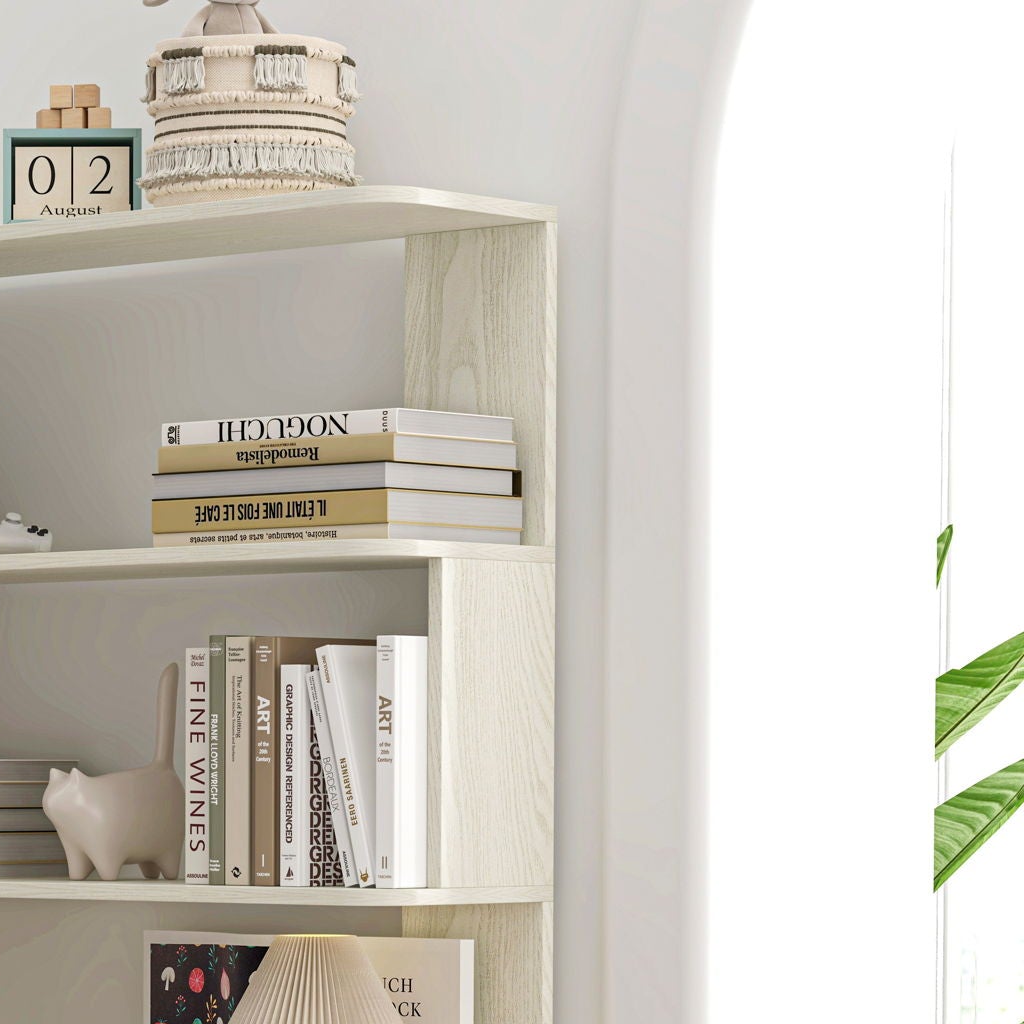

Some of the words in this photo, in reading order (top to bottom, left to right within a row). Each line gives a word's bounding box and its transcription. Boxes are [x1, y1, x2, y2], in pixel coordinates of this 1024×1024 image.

[40, 204, 103, 218] August
[217, 413, 350, 443] NOGUCHI
[236, 446, 320, 465] Remodelista
[194, 505, 220, 526] CAFÉ
[223, 504, 235, 521] LE
[237, 502, 259, 521] FOIS
[262, 501, 283, 519] UNE
[286, 499, 315, 522] ÉTAIT
[317, 499, 327, 517] IL
[189, 534, 216, 543] secrets
[217, 533, 238, 543] petits
[238, 533, 247, 541] et
[249, 532, 264, 541] arts
[266, 530, 304, 542] botanique,
[305, 529, 337, 539] Histoire,
[190, 681, 206, 743] FINE
[257, 695, 271, 734] ART
[285, 683, 293, 730] GRAPHIC
[378, 695, 392, 735] ART
[210, 713, 218, 741] FRANK
[210, 742, 218, 770] LLOYD
[285, 733, 293, 772] DESIGN
[210, 771, 218, 806] WRIGHT
[322, 756, 340, 813] BORDEAUX
[339, 757, 354, 801] SAARINEN
[190, 757, 205, 852] WINES
[285, 775, 293, 844] REFERENCED
[348, 803, 359, 827] EERO
